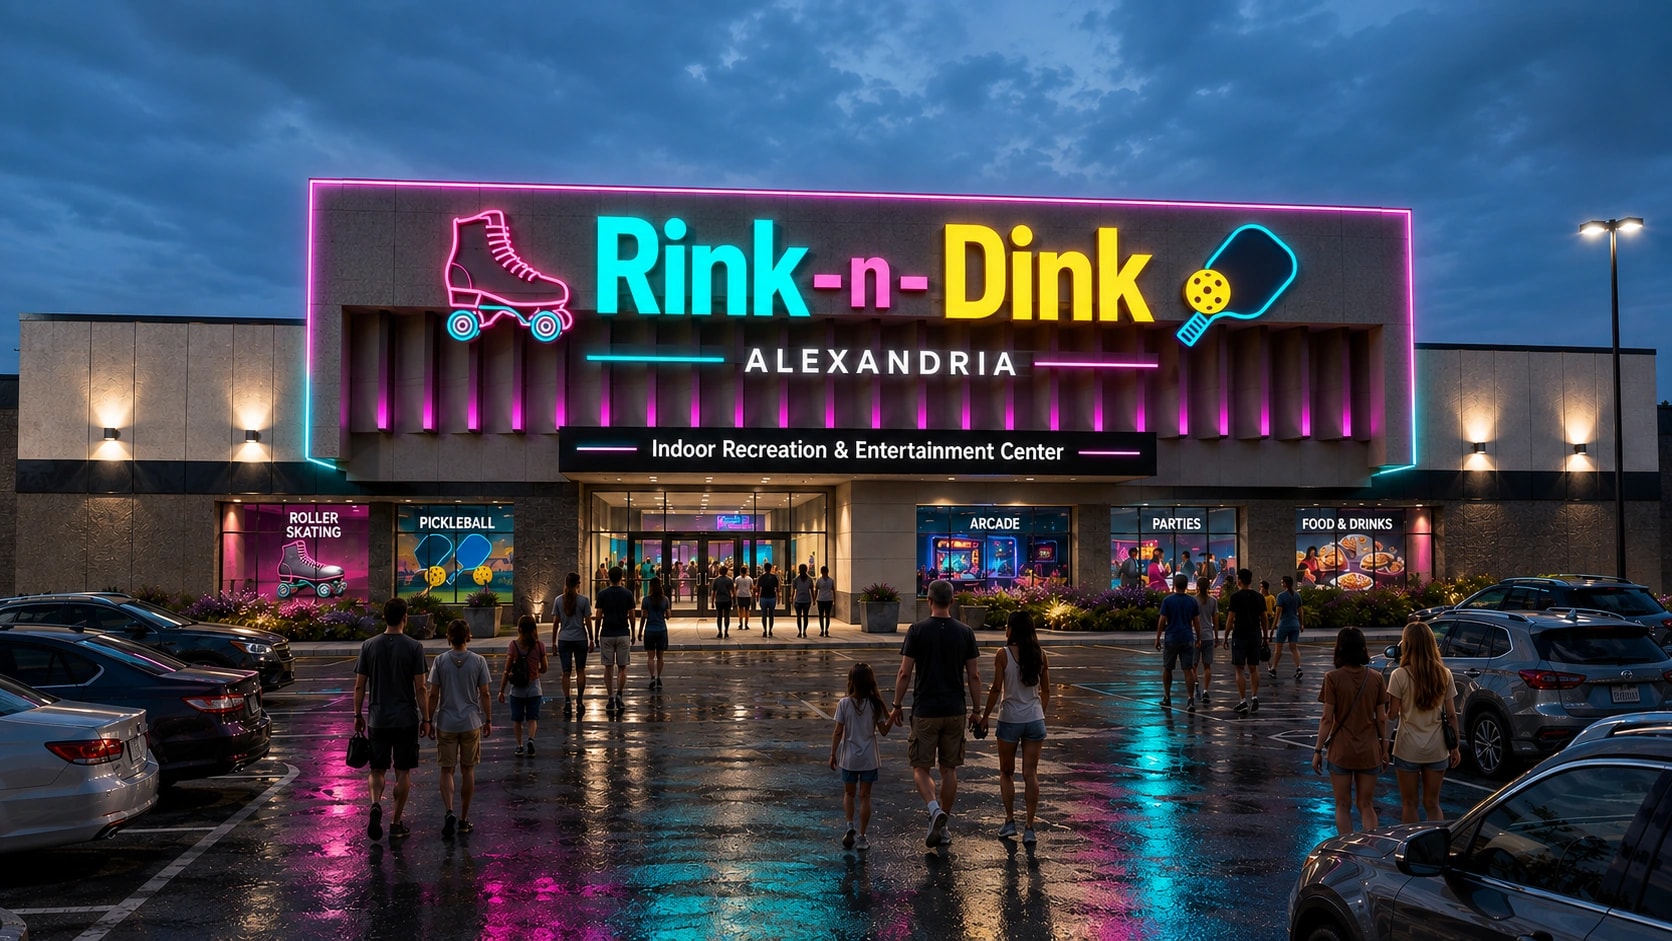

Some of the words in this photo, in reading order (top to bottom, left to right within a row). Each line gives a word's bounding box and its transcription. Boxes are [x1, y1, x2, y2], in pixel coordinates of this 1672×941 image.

[596, 215, 1156, 323] Rink-n-Dink
[744, 347, 1018, 376] ALEXANDRIA
[651, 439, 717, 458] Indoor
[722, 440, 827, 459] Recreation
[834, 441, 849, 459] &
[855, 441, 995, 460] Entertainment
[1000, 442, 1065, 461] Center
[288, 511, 339, 524] ROLLER
[419, 516, 496, 530] PICKLEBALL
[969, 517, 1021, 530] ARCADE
[1152, 517, 1203, 531] PARTIES
[1302, 517, 1335, 531] FOOD
[1337, 517, 1348, 531] &
[1349, 518, 1394, 531] DRINKS
[285, 525, 342, 539] SKATING
